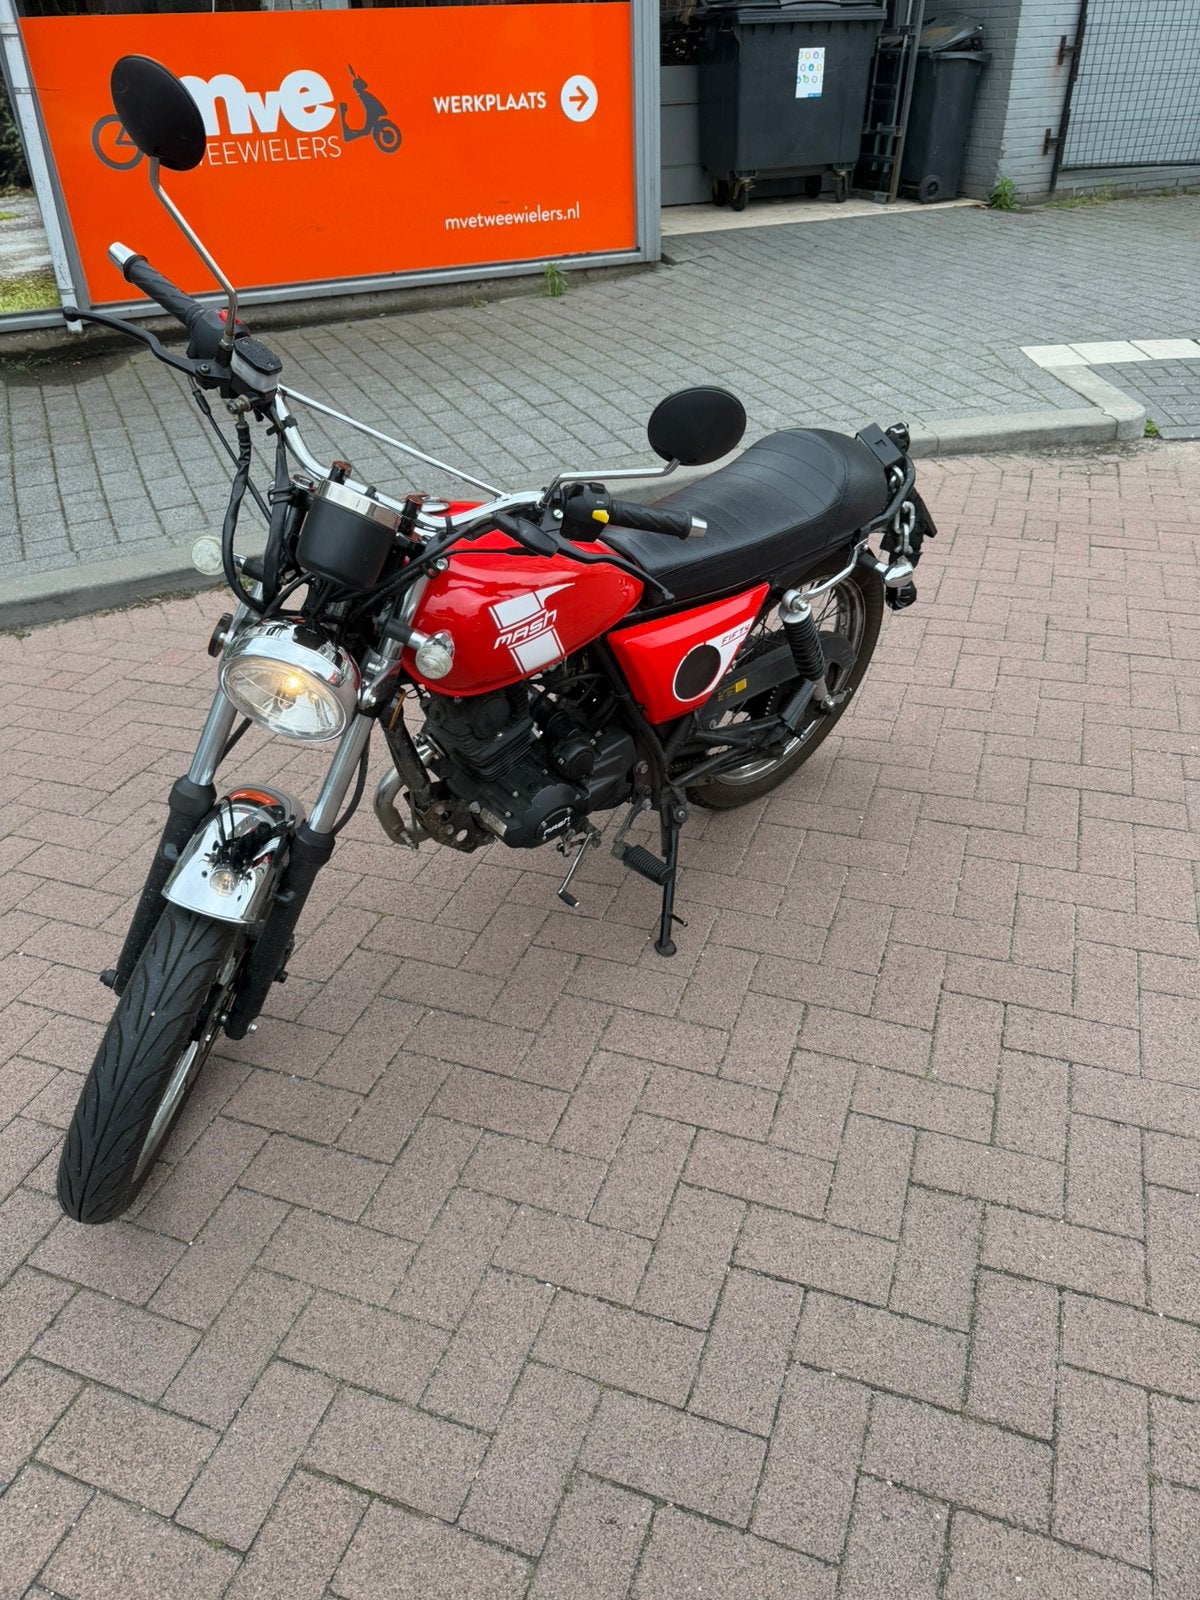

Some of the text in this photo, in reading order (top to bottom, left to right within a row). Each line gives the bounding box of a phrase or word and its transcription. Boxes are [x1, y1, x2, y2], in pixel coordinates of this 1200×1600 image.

[433, 91, 547, 114] WERKPLAATS
[199, 135, 342, 167] EEWIELERS
[445, 201, 580, 230] mvetweewielers.nl
